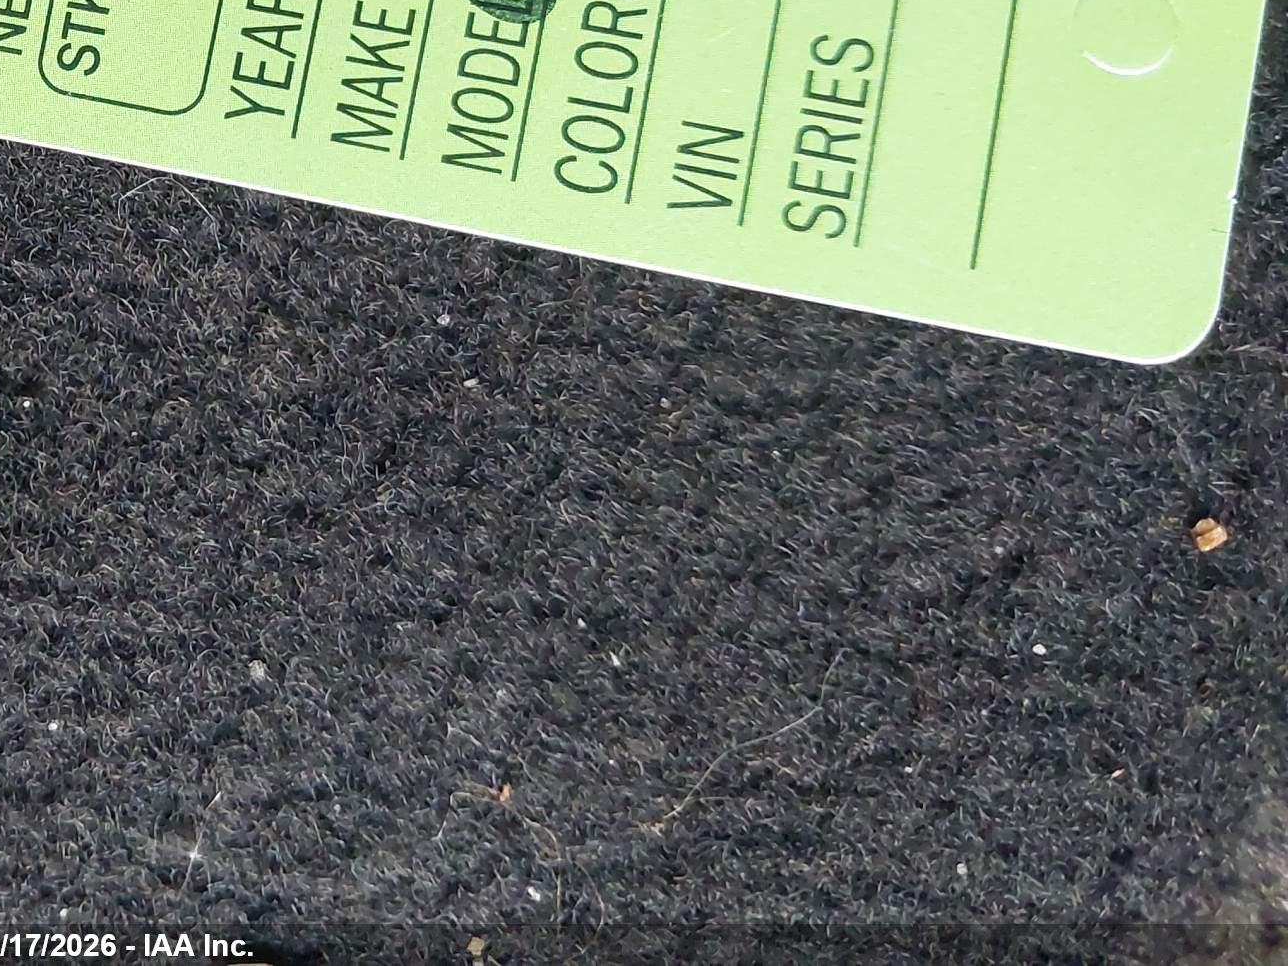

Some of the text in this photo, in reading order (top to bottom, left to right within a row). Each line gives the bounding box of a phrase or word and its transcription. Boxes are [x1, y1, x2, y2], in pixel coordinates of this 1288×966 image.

[330, 0, 417, 153] MAKE
[554, 0, 649, 194] COLOR
[781, 33, 875, 239] SERIES
[667, 119, 745, 210] VIN
